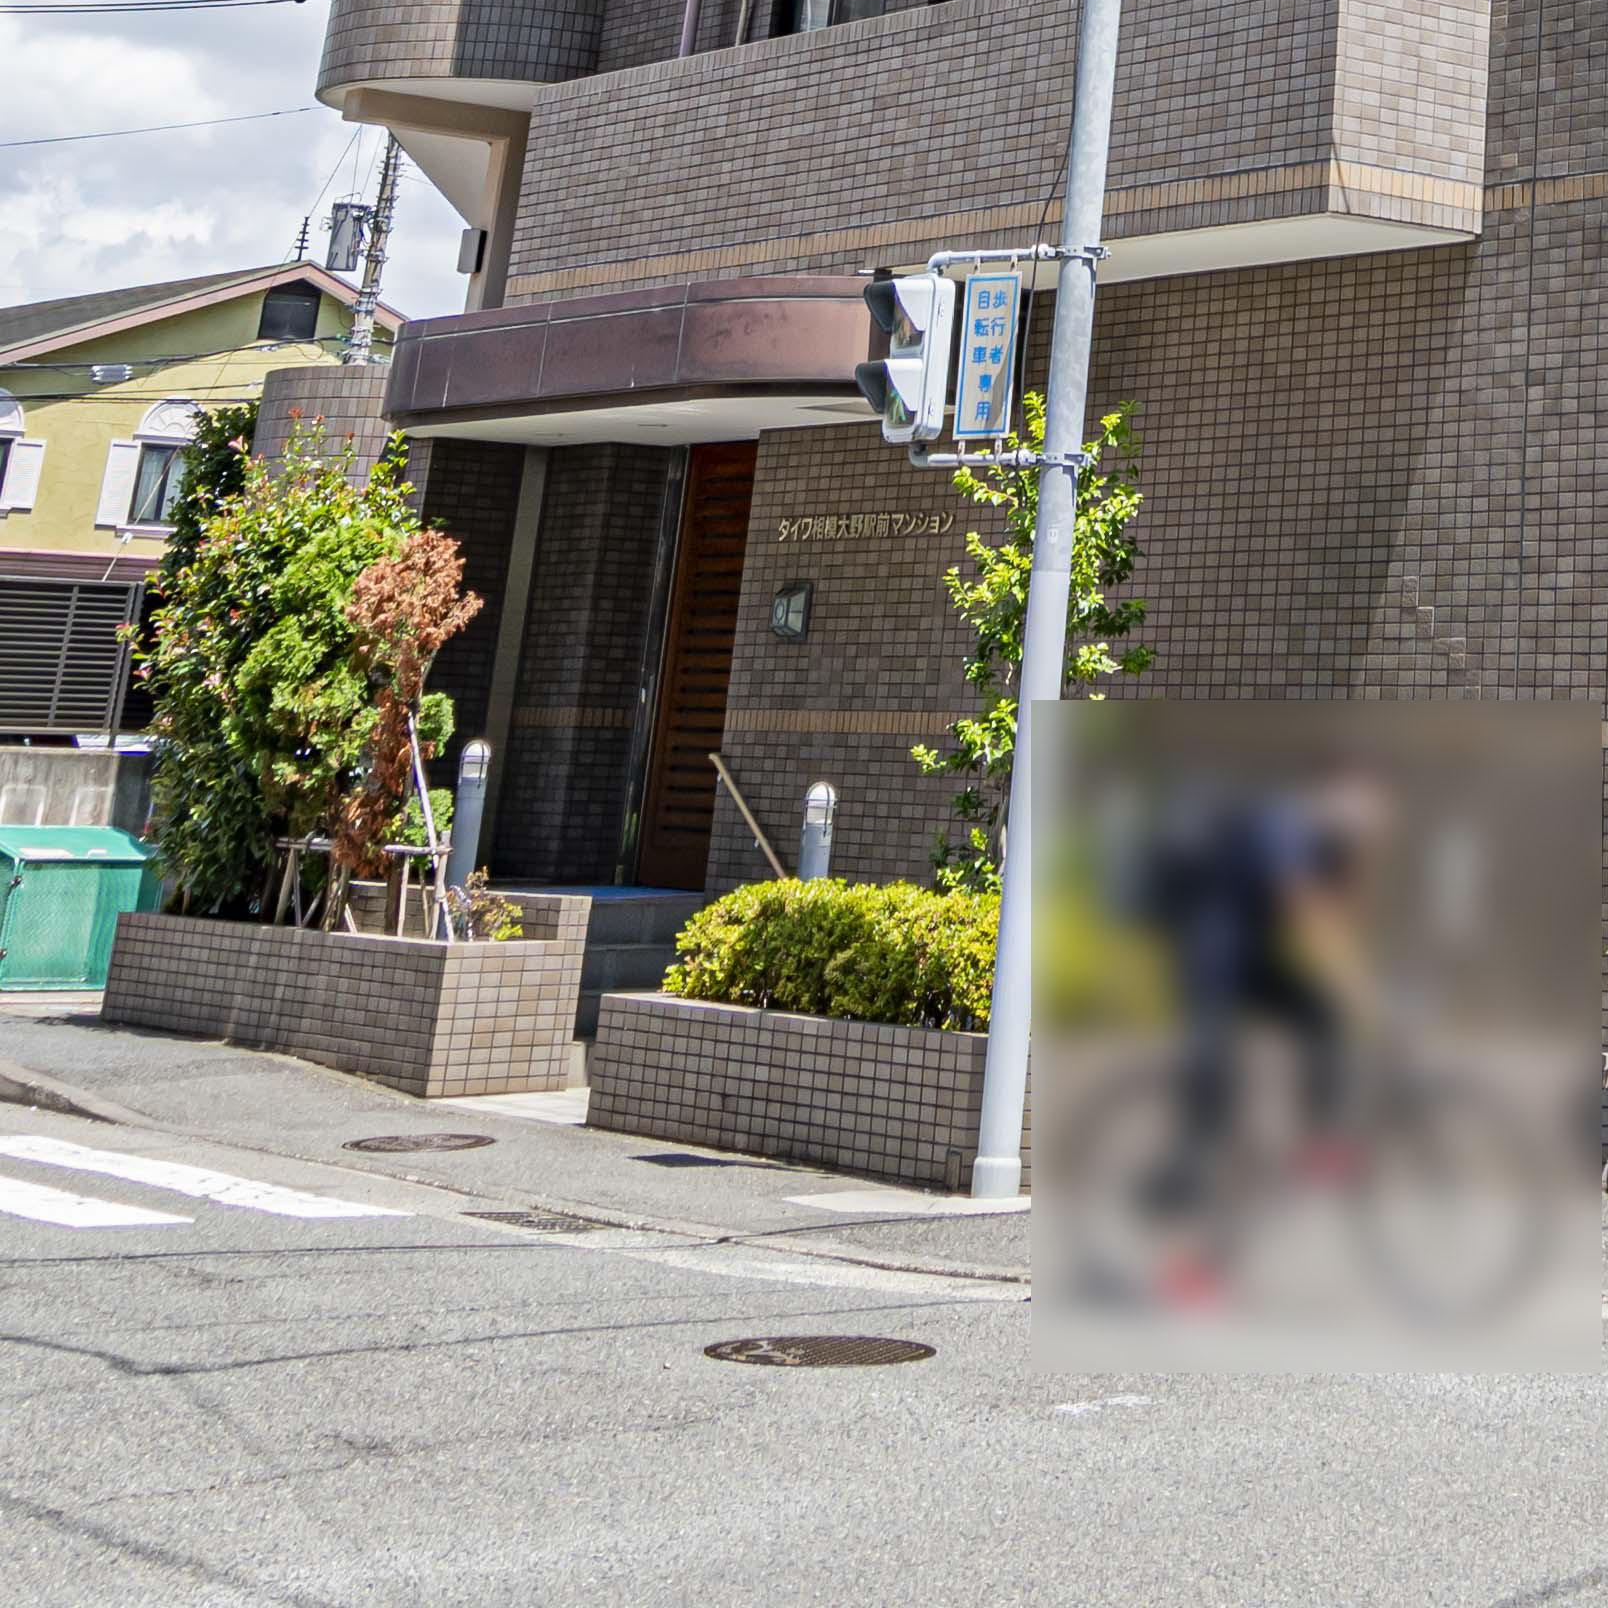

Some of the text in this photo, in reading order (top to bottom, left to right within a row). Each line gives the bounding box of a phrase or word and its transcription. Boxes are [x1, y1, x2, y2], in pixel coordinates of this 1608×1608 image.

[972, 290, 991, 364] 自転車
[990, 289, 1008, 365] 歩行者
[974, 374, 993, 422] 専用
[778, 511, 955, 542] ダイワ相模大野駅前マンション
